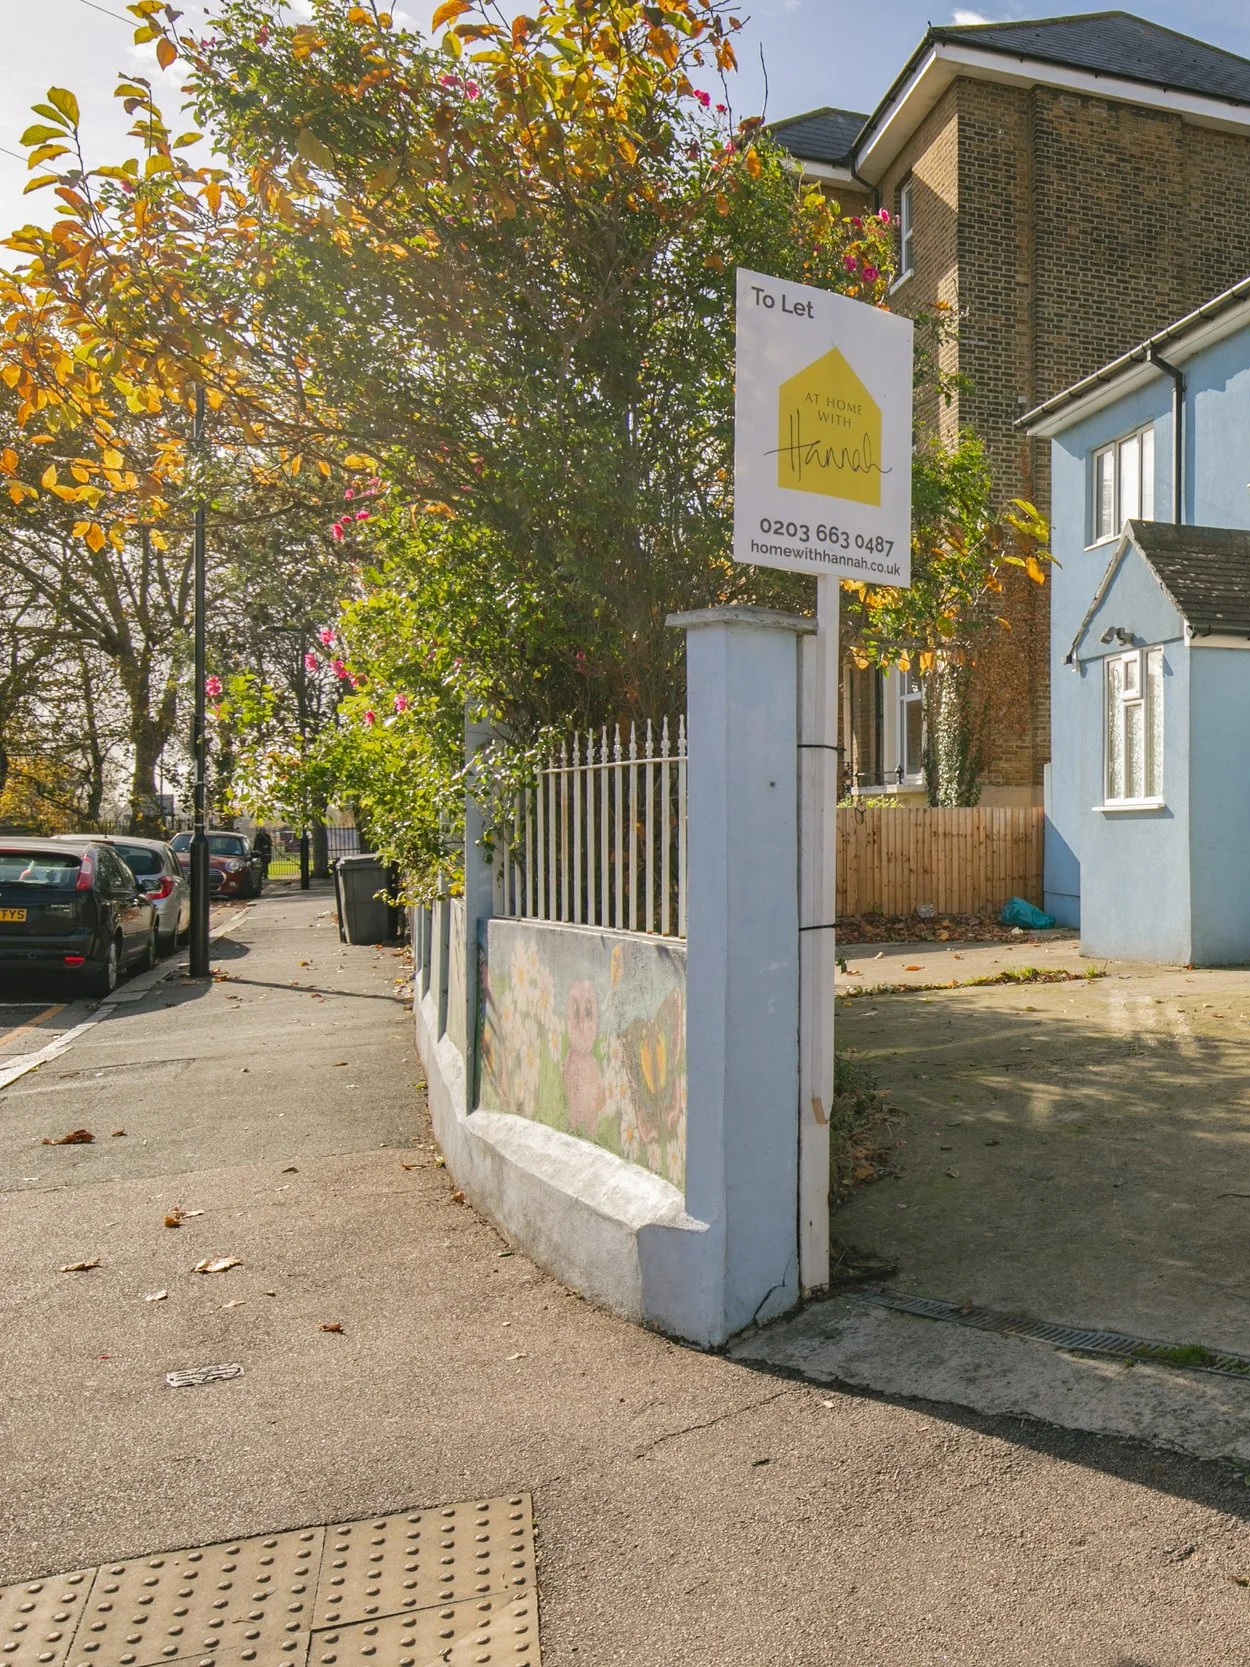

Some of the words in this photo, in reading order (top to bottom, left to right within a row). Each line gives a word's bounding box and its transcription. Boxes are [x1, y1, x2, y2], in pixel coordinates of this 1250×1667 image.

[751, 286, 775, 309] To
[781, 294, 814, 319] Let
[804, 392, 820, 405] AT
[826, 396, 862, 416] HOME
[817, 410, 851, 428] WITH
[763, 408, 893, 482] Hannah
[760, 518, 810, 542] 0203
[816, 524, 850, 549] 663
[855, 534, 894, 557] 0487
[750, 539, 901, 575] homewithhannah.co.uk
